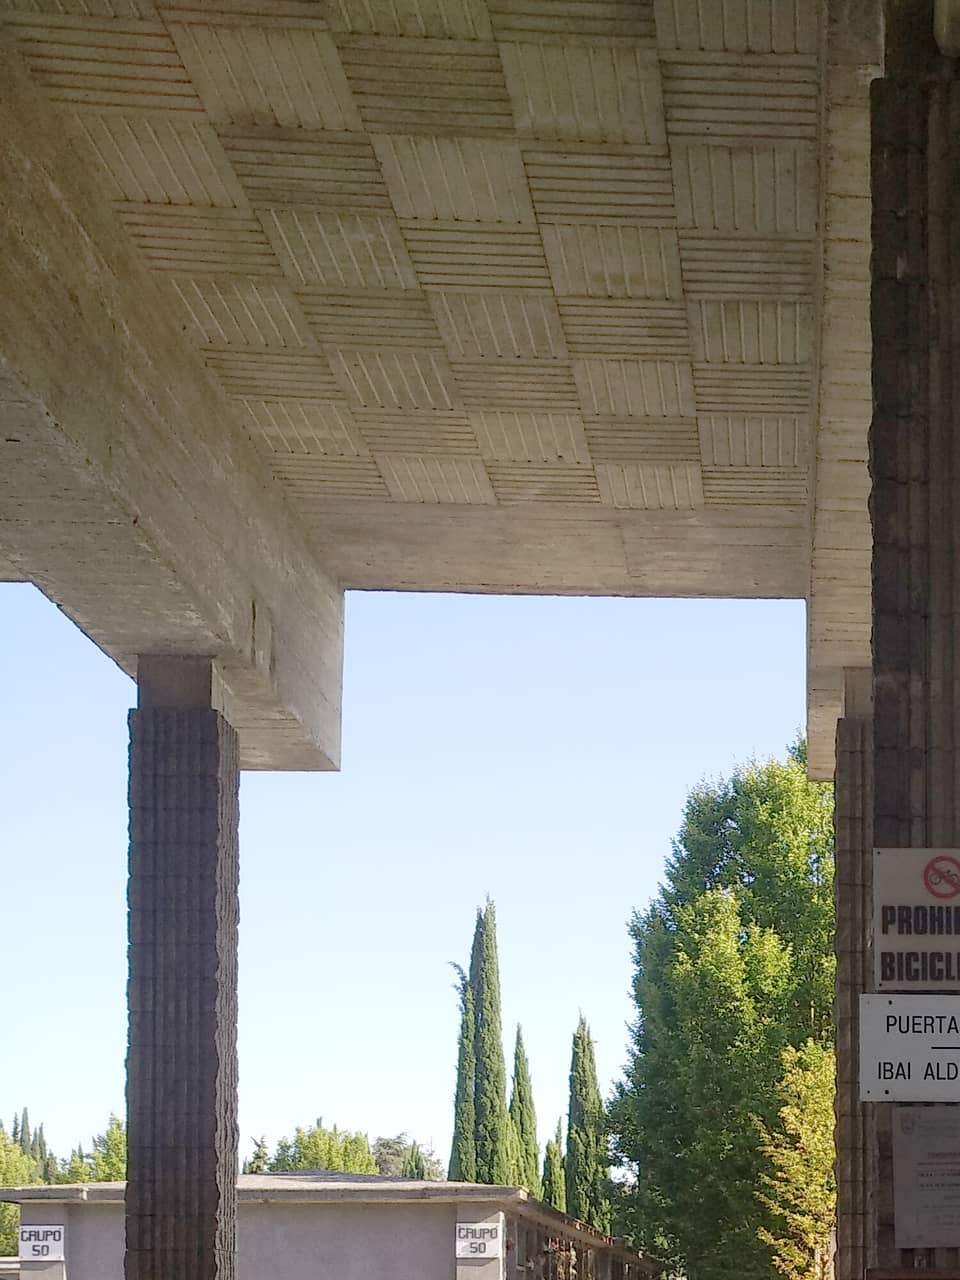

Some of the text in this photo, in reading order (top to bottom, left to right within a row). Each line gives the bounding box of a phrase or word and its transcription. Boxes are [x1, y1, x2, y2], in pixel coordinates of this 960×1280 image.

[886, 1015, 959, 1034] PUERTA
[877, 1062, 911, 1080] IBAI
[21, 1230, 61, 1241] GRUPO
[458, 1227, 498, 1239] GRUPO
[32, 1245, 49, 1256] 50
[469, 1242, 486, 1253] 50
